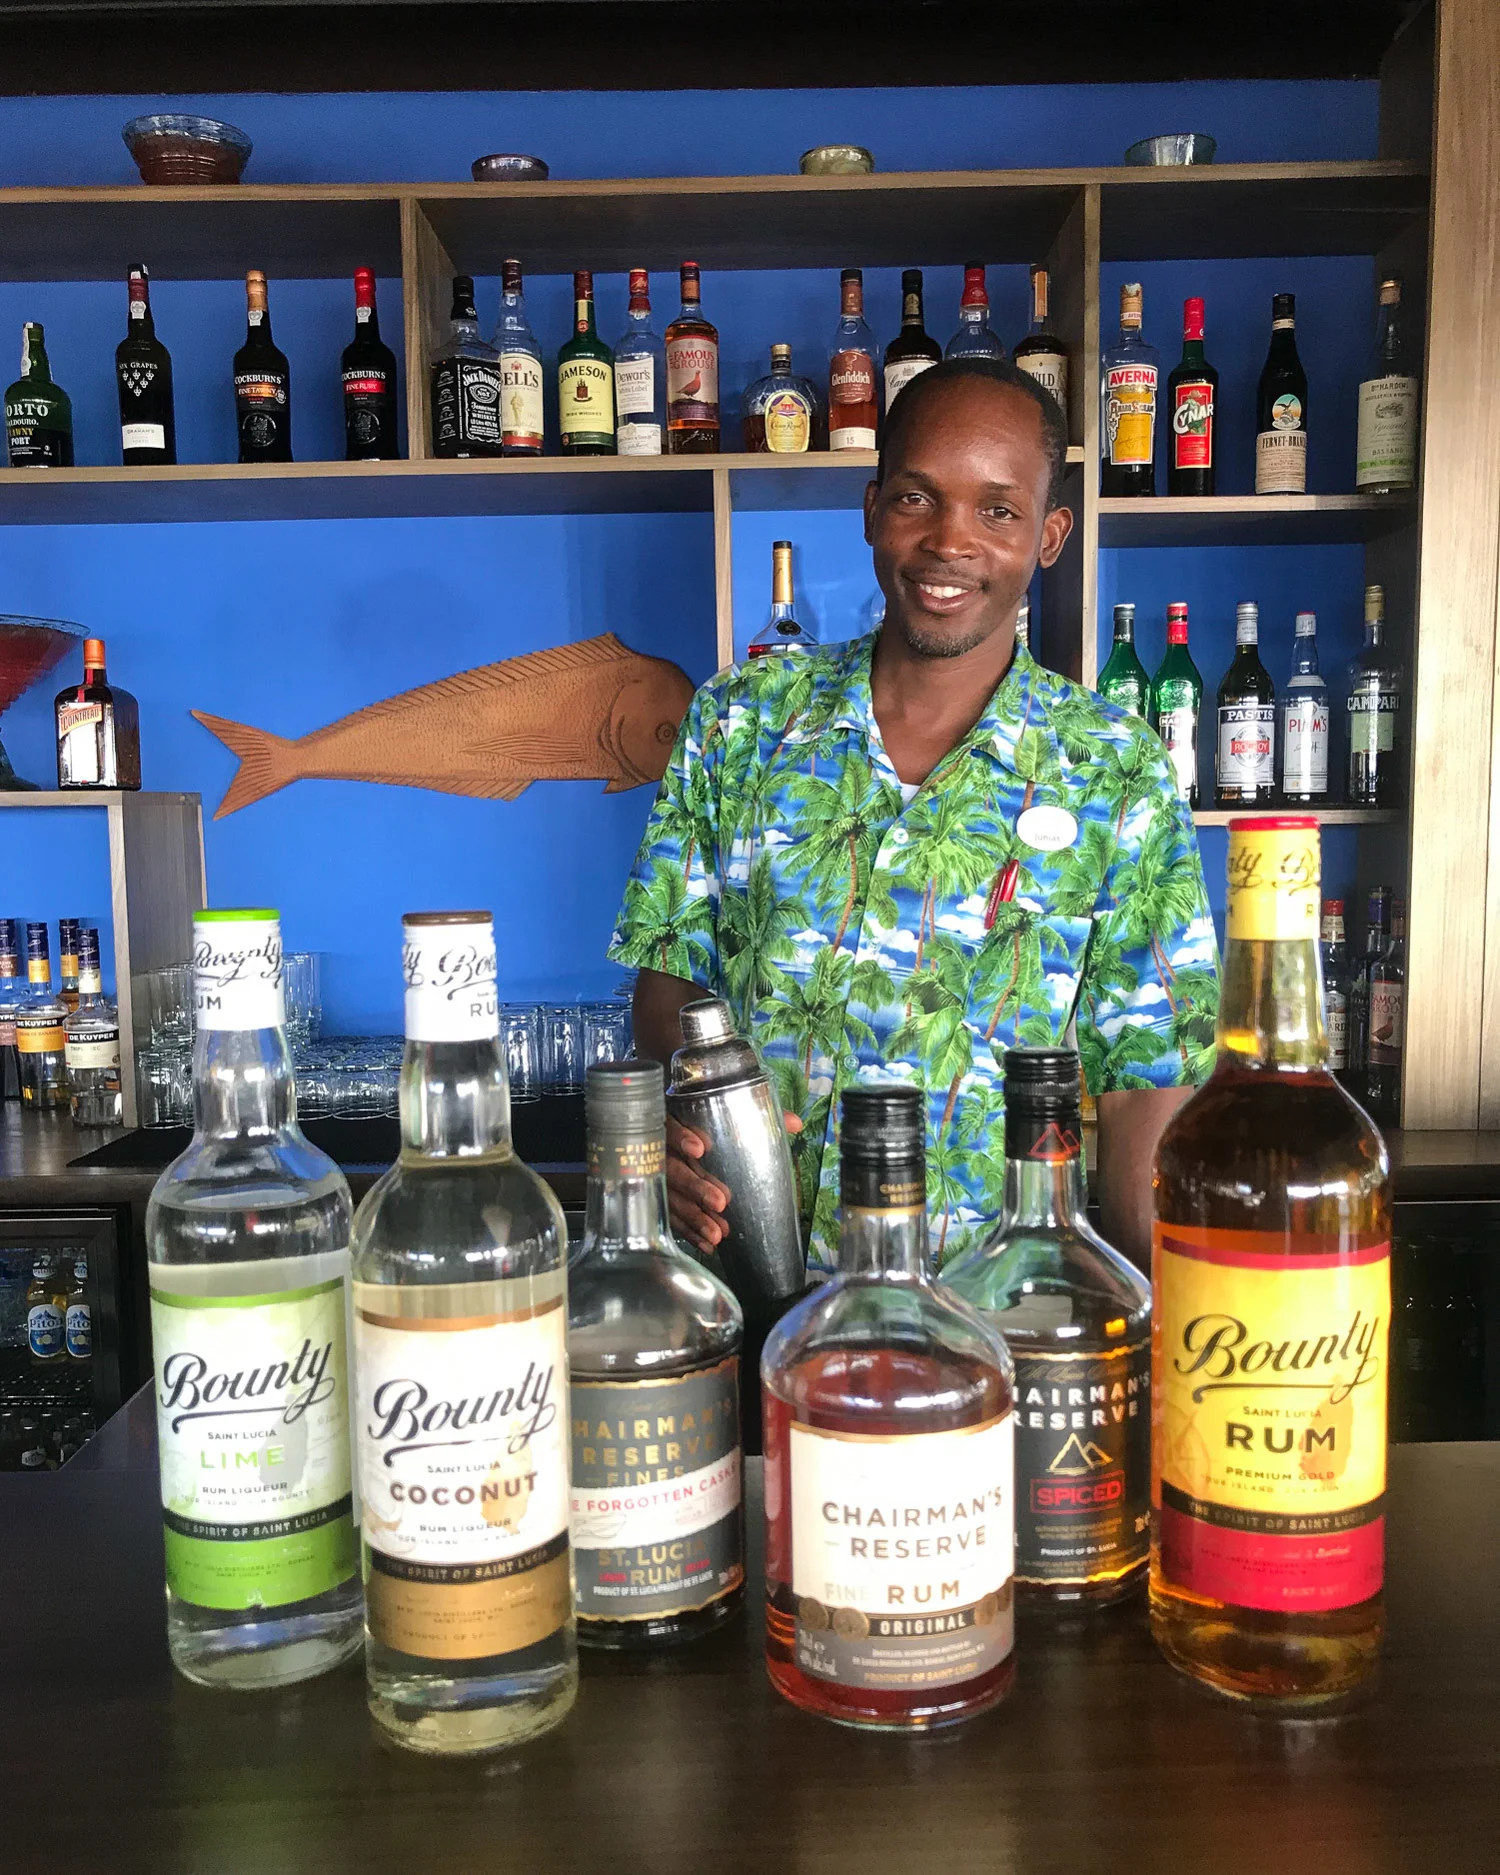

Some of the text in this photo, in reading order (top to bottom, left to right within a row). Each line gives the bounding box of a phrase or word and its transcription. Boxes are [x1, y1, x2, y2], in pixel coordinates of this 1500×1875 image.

[674, 349, 715, 361] FAMOUS
[130, 361, 158, 370] GRAPES
[560, 365, 607, 384] JAMESON
[674, 360, 715, 370] GROUSE
[500, 370, 539, 389] ELL'S
[616, 369, 651, 383] Dewar's
[831, 370, 871, 387] Glenfiddich
[1109, 370, 1156, 386] AVERNA
[1173, 403, 1214, 435] CYNAR
[11, 436, 31, 446] PORT
[846, 436, 855, 445] 15
[62, 707, 100, 732] COINTREAU
[1226, 709, 1274, 722] PASTIS
[1288, 715, 1328, 733] PIM'S
[24, 1018, 58, 1028] KUYPER
[79, 1032, 114, 1041] KUYPER
[29, 1317, 62, 1329] Piton
[1173, 1310, 1380, 1405] Bounty
[159, 1338, 336, 1434] Bounty
[367, 1361, 558, 1468] Bounty
[1010, 1399, 1139, 1431] RESERVE
[1242, 1405, 1323, 1419] SAINT LUCIA
[207, 1429, 278, 1440] SAINT LUCIA
[1225, 1420, 1336, 1454] RUM
[200, 1444, 286, 1470] LIME
[582, 1433, 716, 1468] RESERVE
[427, 1460, 502, 1474] SAINT LUCIA
[1225, 1466, 1336, 1481] PREMIUM GOLD
[202, 1482, 289, 1496] RUM LIQUEUR
[389, 1471, 539, 1506] COCONUT
[1035, 1479, 1123, 1507] SPICED
[586, 1485, 694, 1513] FORGOTTEN
[821, 1485, 1003, 1528] CHAIRMAN'S
[193, 1526, 229, 1538] SPIRIT
[232, 1527, 249, 1538] OF
[253, 1521, 292, 1537] SAINT
[295, 1510, 329, 1529] LUCIA
[419, 1517, 513, 1534] RUM LIQUEUR
[1214, 1510, 1261, 1527] SPIRIT
[1265, 1518, 1284, 1531] OF
[1288, 1517, 1331, 1531] SAINT
[850, 1524, 987, 1560] RESERVE
[598, 1549, 632, 1568] ST.
[636, 1538, 707, 1567] LUCIA
[1040, 1547, 1075, 1557] PRODUCT
[1075, 1547, 1085, 1556] OF
[407, 1566, 449, 1580] SPIRIT
[452, 1568, 471, 1580] OF
[474, 1561, 514, 1577] SAINT
[629, 1563, 683, 1586] RUM
[592, 1585, 621, 1597] PRODUCT
[620, 1586, 630, 1596] OF
[824, 1579, 961, 1605] FINE RUM
[879, 1612, 968, 1637] ORIGINAL
[863, 1671, 911, 1685] PRODUCT
[911, 1671, 926, 1683] OF
[926, 1667, 953, 1683] SAINT
